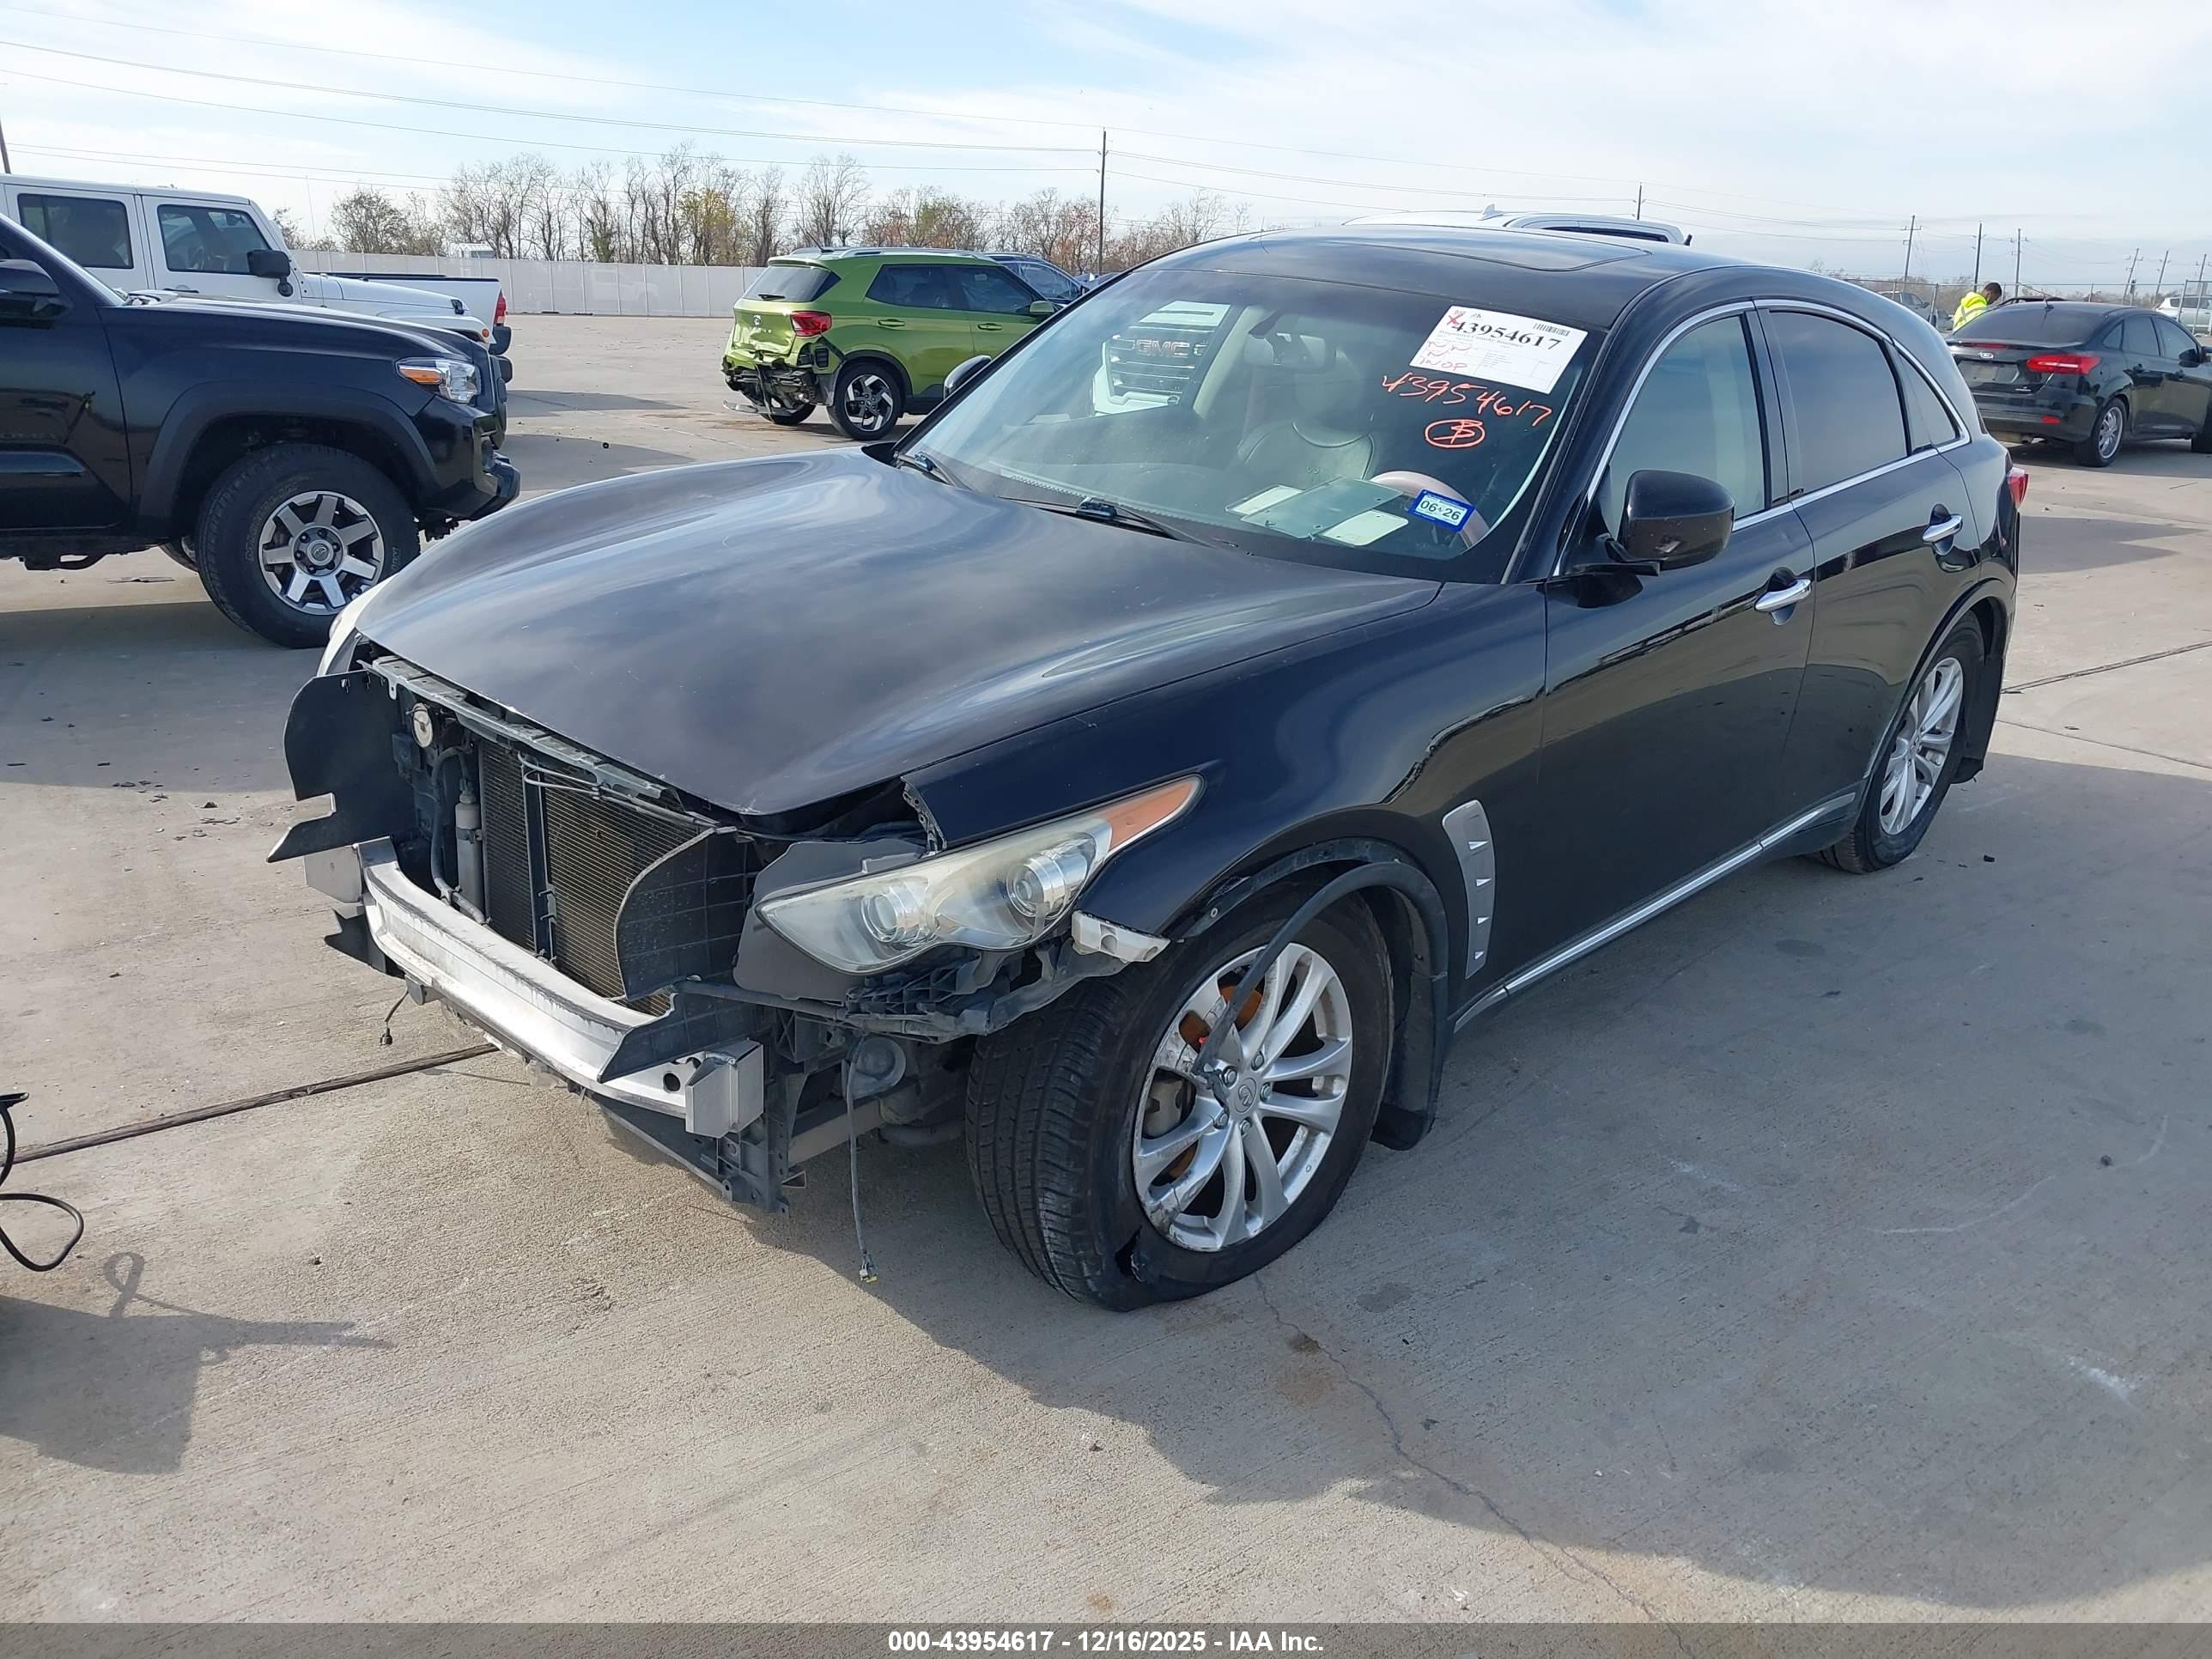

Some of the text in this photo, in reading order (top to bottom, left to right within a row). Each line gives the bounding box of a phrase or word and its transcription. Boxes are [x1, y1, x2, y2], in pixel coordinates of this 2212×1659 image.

[1451, 321, 1562, 350] 43954617
[1136, 339, 1190, 358] GMC
[1382, 372, 1553, 427] 43954617
[1420, 500, 1438, 513] 06
[1442, 507, 1462, 520] 26
